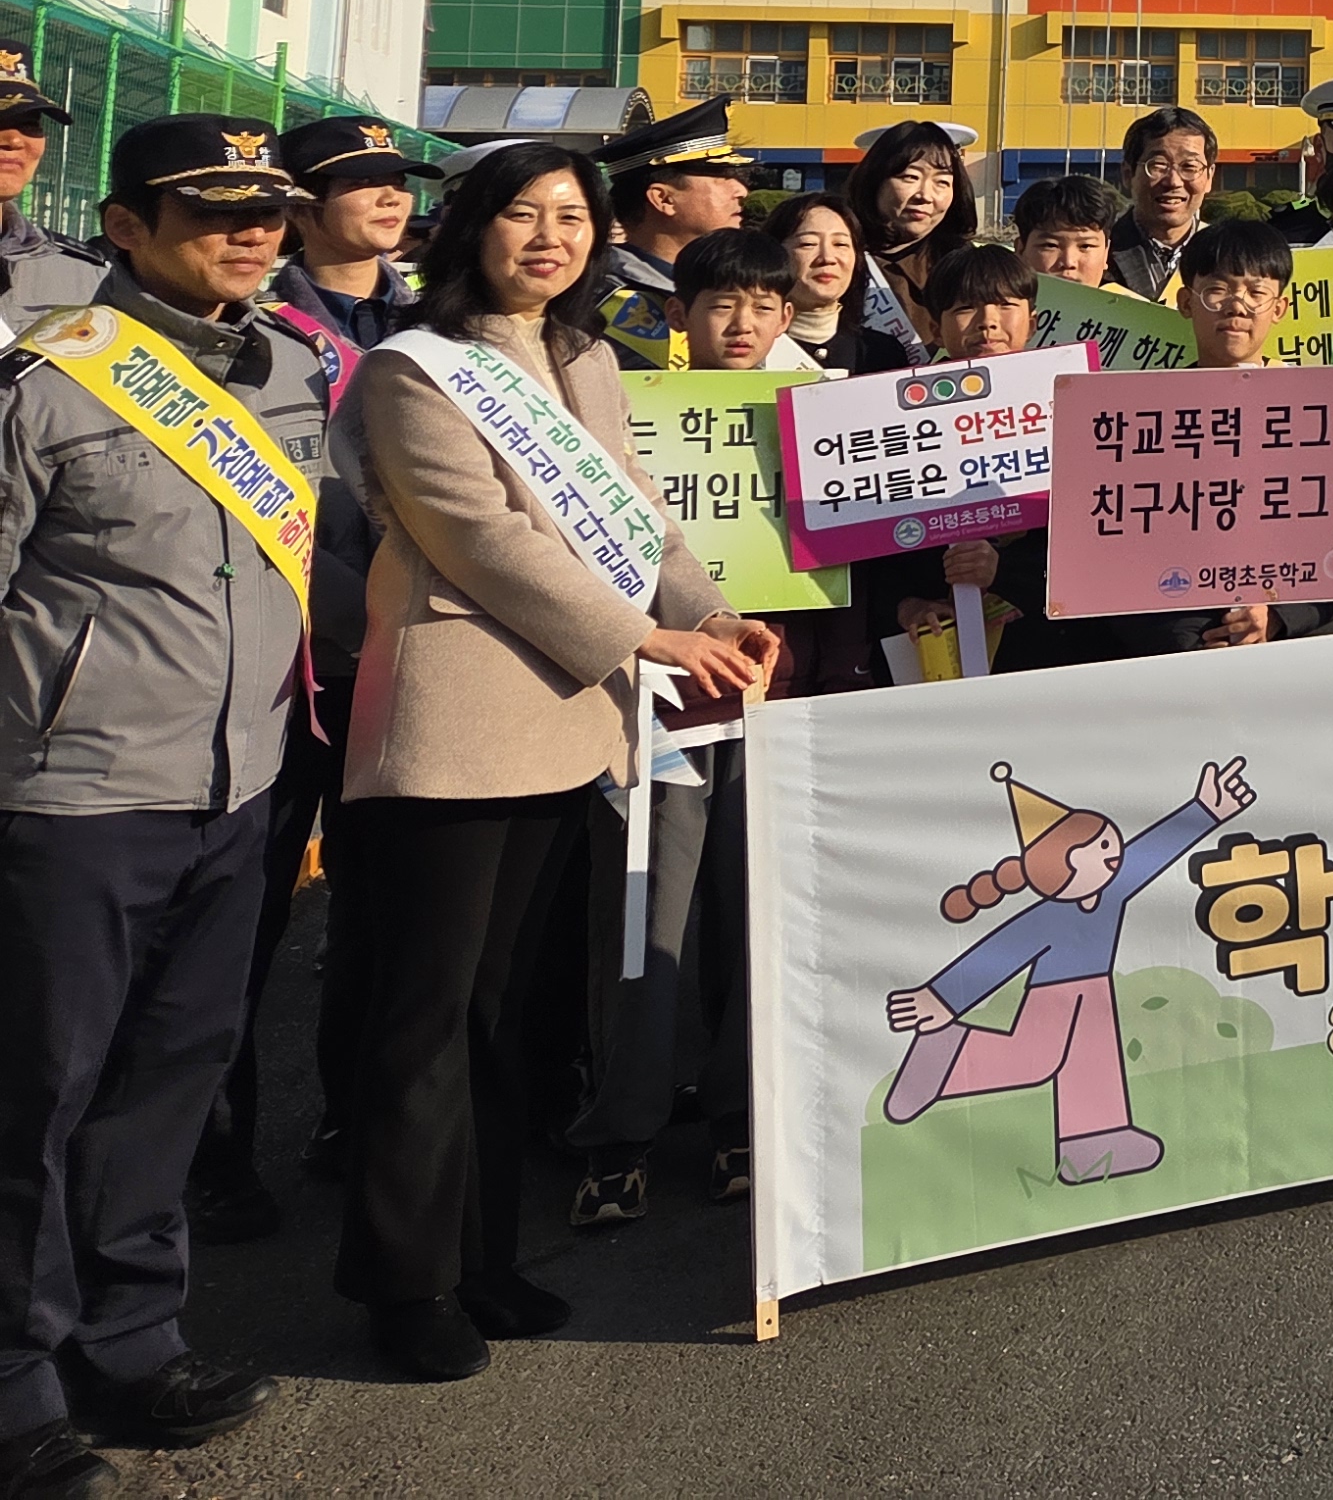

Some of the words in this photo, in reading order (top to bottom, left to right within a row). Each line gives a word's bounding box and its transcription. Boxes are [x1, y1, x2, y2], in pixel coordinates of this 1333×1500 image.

[288, 437, 319, 461] 경찰
[448, 367, 512, 429] 작은
[499, 421, 562, 484] 관심
[679, 407, 758, 454] 학교
[813, 419, 943, 466] 어른들은
[954, 400, 1053, 445] 안전운
[1092, 405, 1245, 461] 학교폭력
[466, 343, 526, 396] 친구
[523, 394, 582, 453] 사랑
[575, 452, 635, 516] 학교
[623, 507, 665, 566] 사랑
[819, 463, 948, 513] 우리들은
[959, 446, 1050, 490] 안전보
[928, 502, 1022, 531] 의령초등학교
[1090, 479, 1245, 536] 친구사랑
[1198, 560, 1318, 593] 의령초등학교
